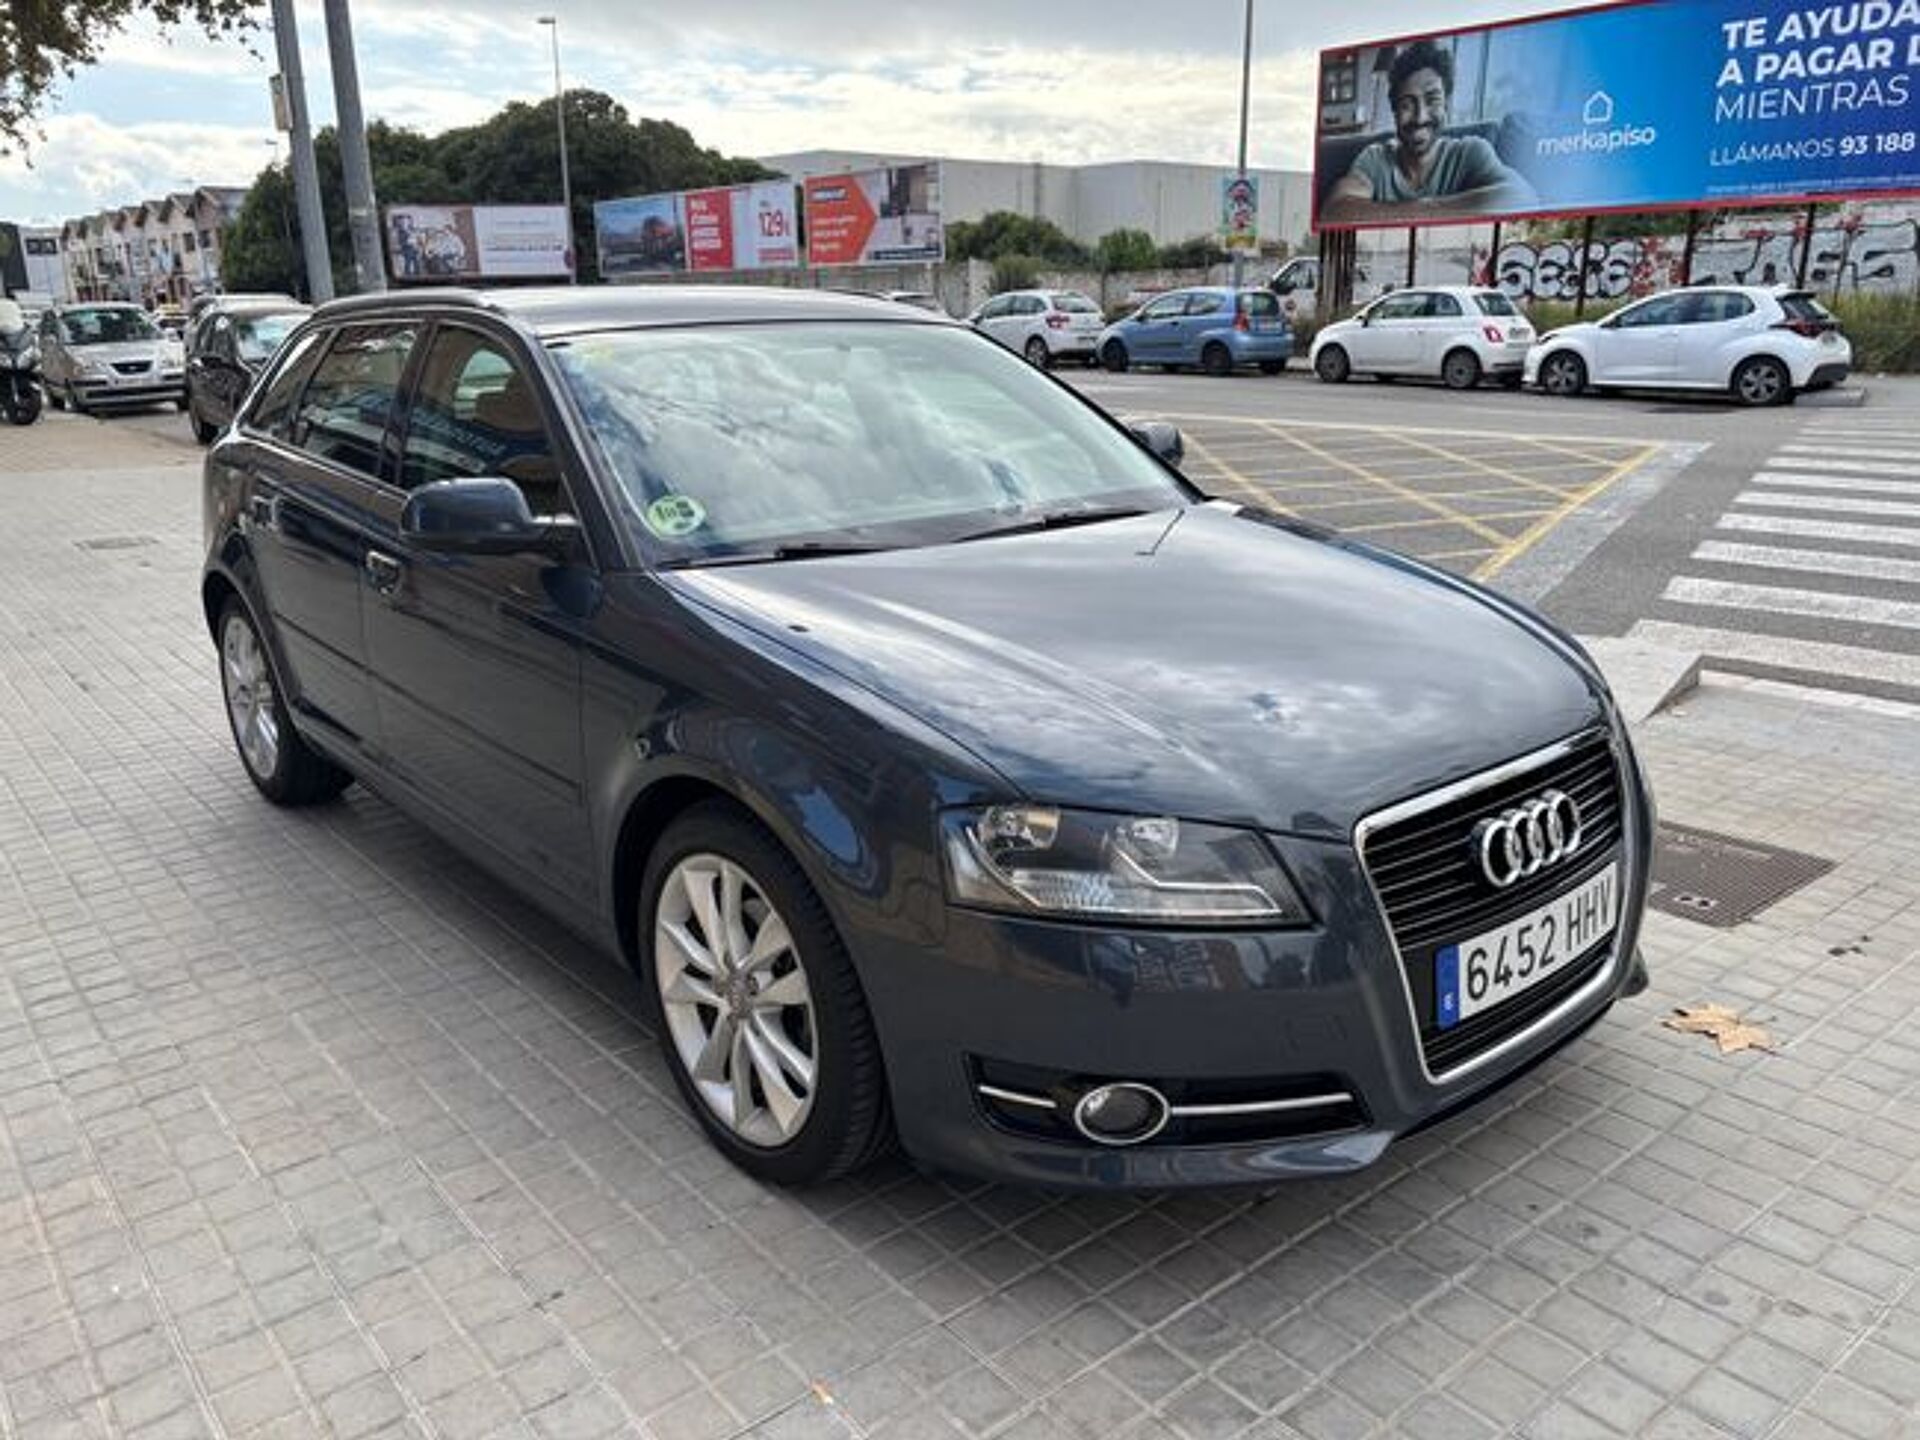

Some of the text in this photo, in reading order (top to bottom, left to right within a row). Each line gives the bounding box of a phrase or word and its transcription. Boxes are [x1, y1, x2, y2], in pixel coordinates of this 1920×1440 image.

[1722, 17, 1768, 51] TE
[1716, 58, 1744, 88] A
[1754, 37, 1895, 83] PAGAR
[1715, 73, 1910, 124] MIENTRAS
[1535, 123, 1657, 154] merkapiso
[1710, 132, 1916, 166] LLÁMANOS 93 188
[1466, 875, 1613, 1001] 6452 HHV
